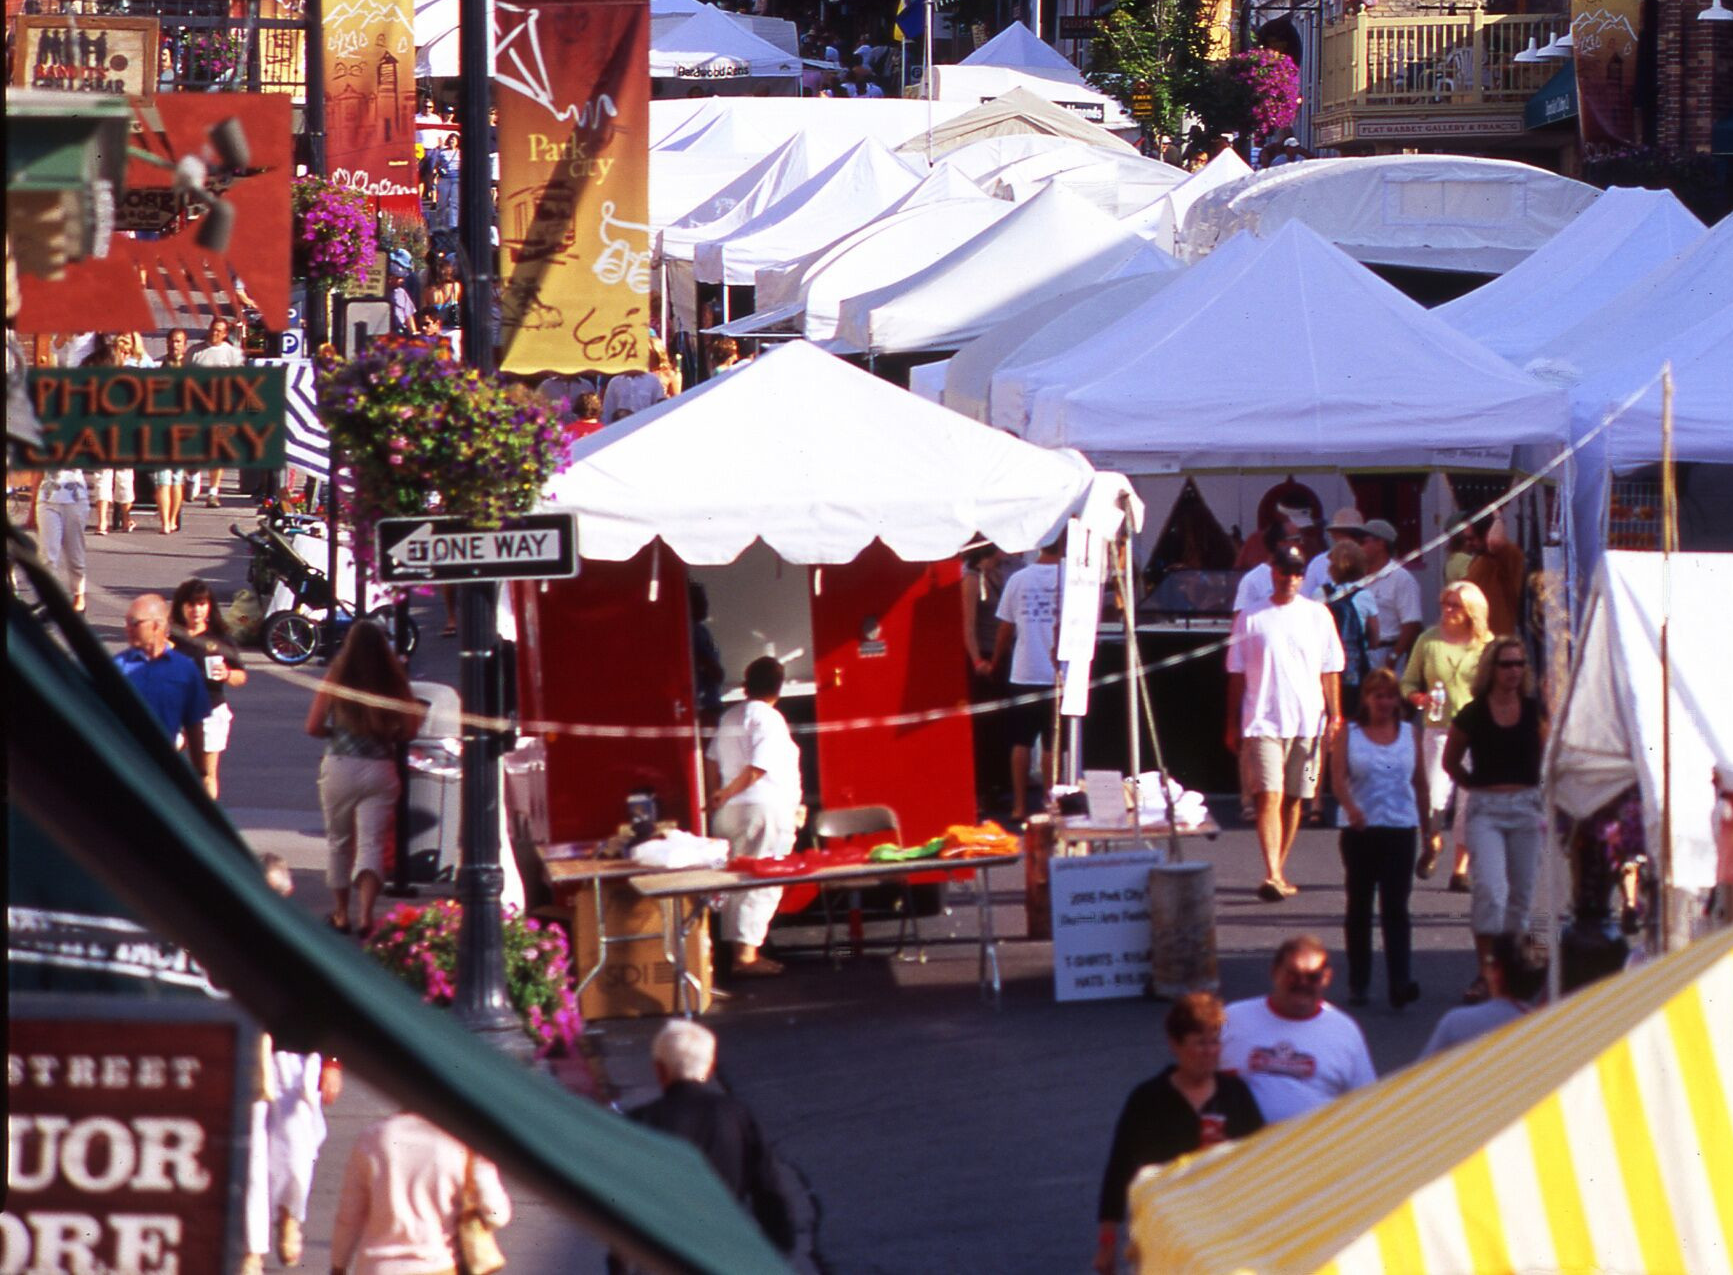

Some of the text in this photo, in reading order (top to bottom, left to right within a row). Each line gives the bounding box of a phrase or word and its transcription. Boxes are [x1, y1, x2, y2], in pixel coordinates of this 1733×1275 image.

[528, 132, 587, 163] Park
[569, 157, 615, 186] city
[34, 374, 267, 416] PHOENIX
[24, 423, 275, 464] GALLERY
[432, 532, 549, 562] ONE WAY
[8, 1115, 213, 1193] UOR
